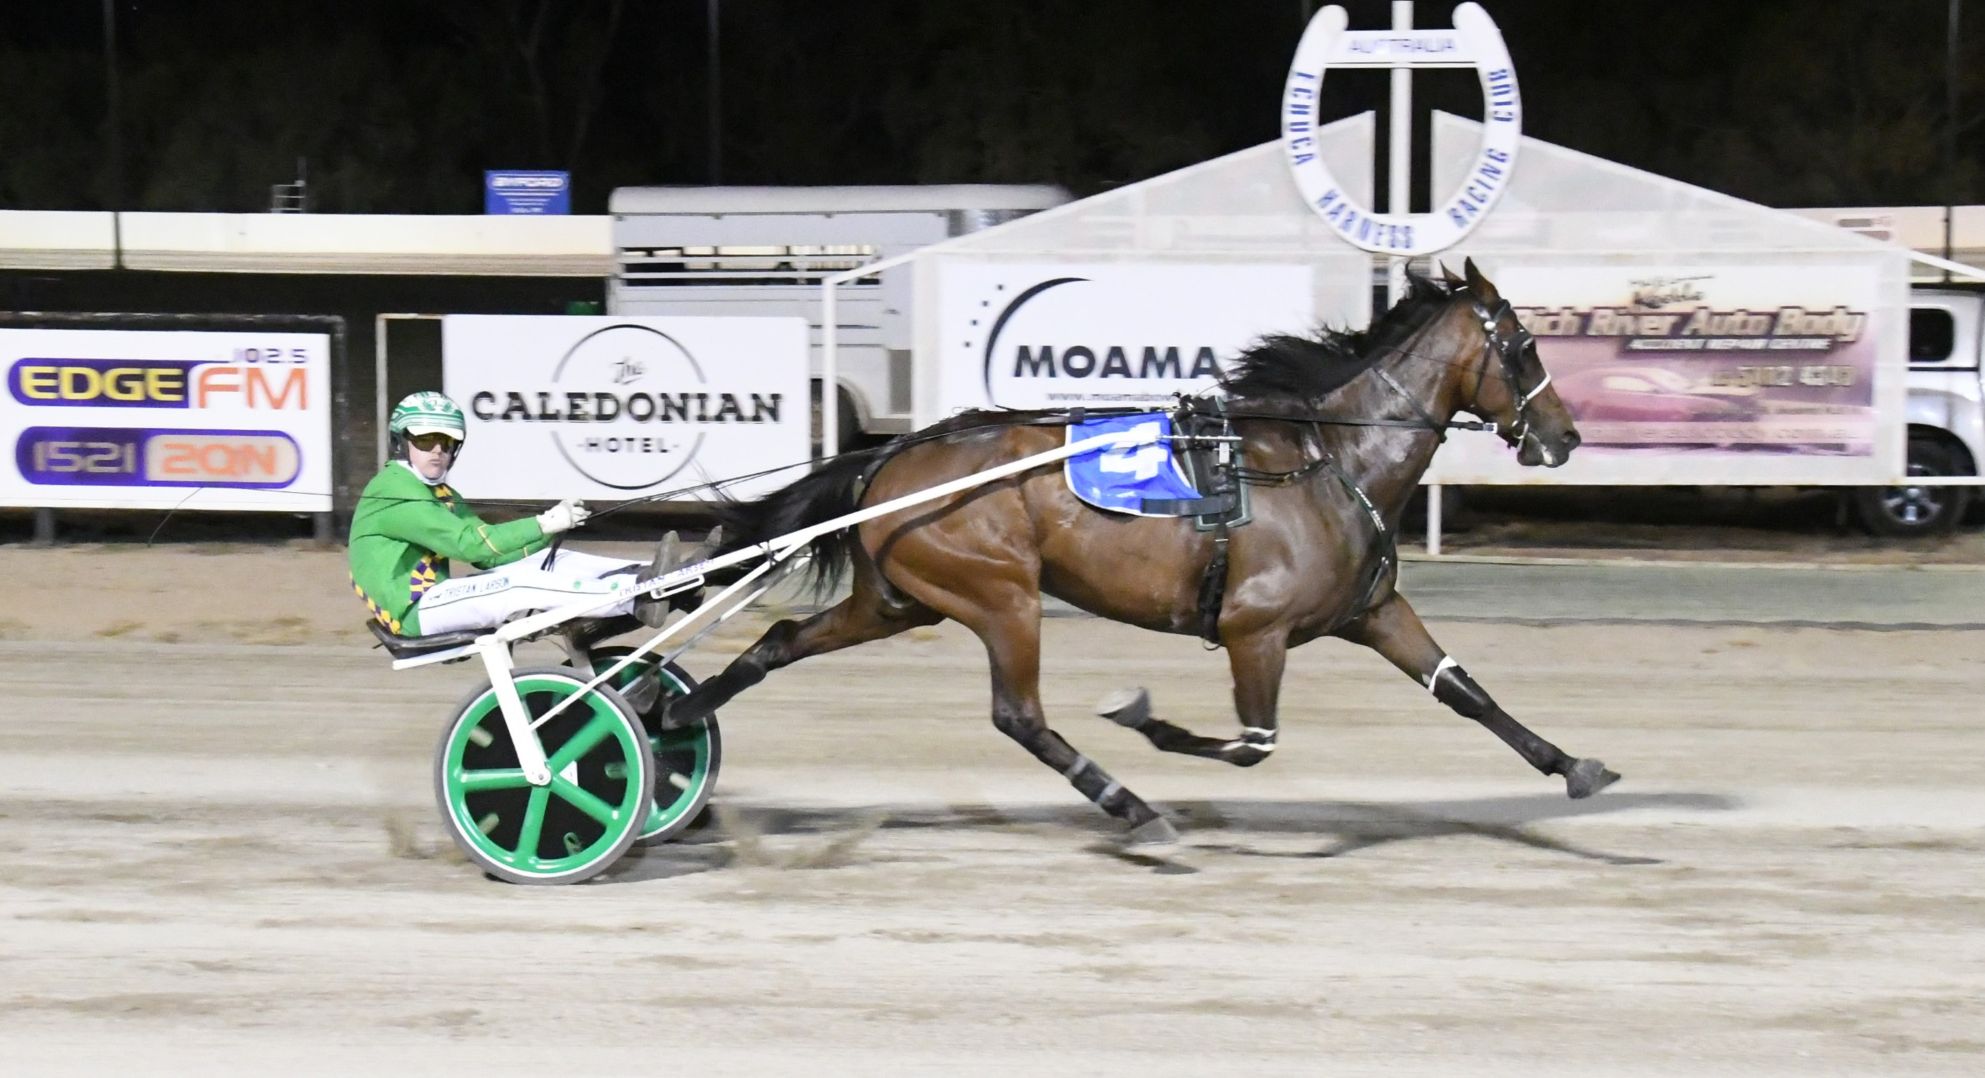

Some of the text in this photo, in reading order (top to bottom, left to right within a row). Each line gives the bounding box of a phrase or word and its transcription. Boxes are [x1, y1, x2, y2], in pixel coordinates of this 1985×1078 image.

[1348, 38, 1457, 54] AUTRALIA
[1448, 148, 1509, 229] RACING
[1678, 307, 1770, 336] Auto
[1772, 306, 1868, 344] Body
[1013, 345, 1225, 380] MOAMA
[19, 365, 309, 411] EDGE FM
[471, 390, 784, 424] CALEDONIAN
[33, 440, 137, 474] 1521
[1099, 421, 1167, 481] 4
